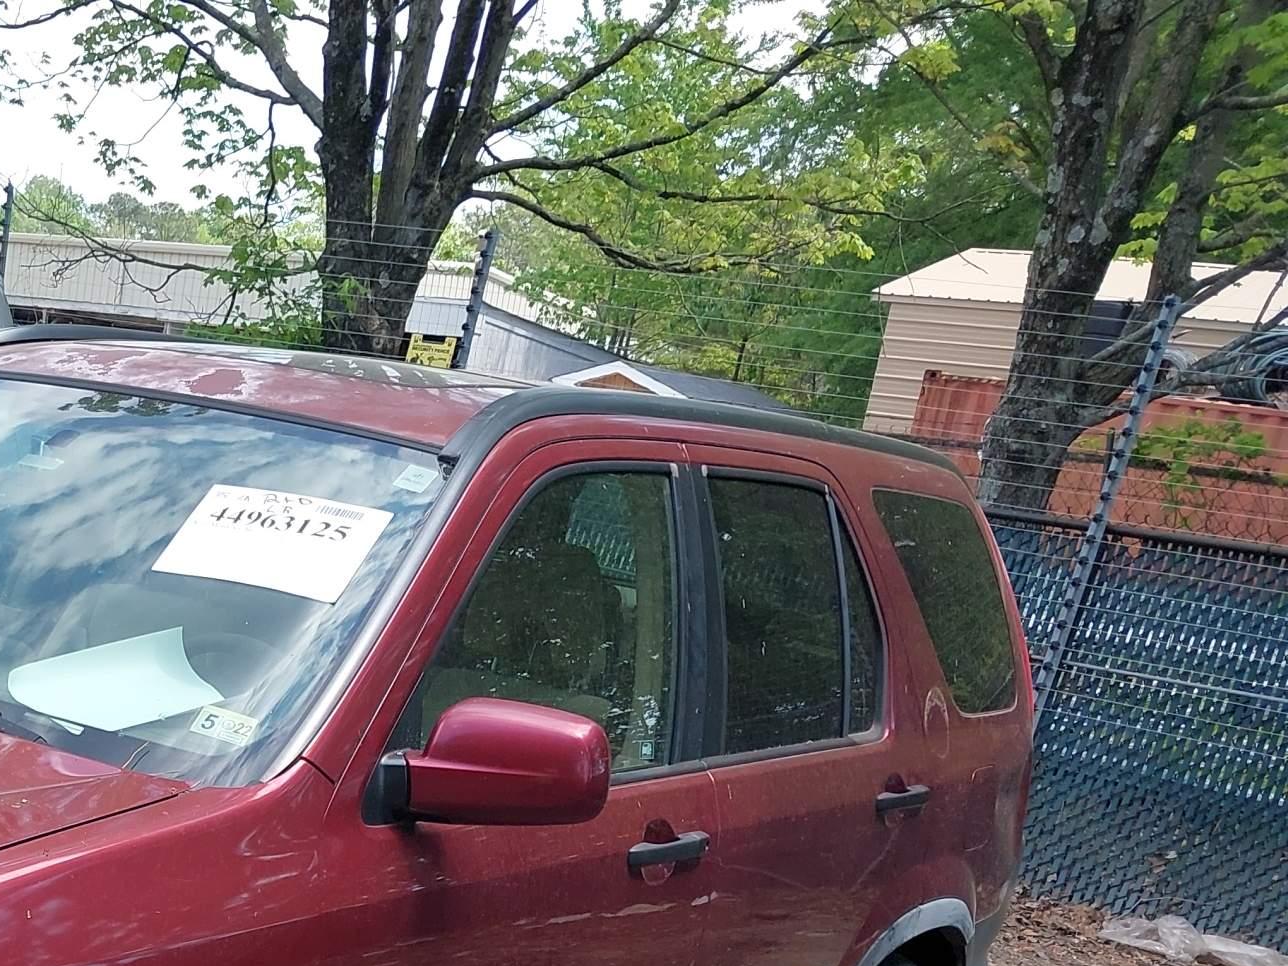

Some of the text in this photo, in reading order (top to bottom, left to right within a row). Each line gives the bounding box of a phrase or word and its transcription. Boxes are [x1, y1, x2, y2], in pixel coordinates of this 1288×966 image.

[210, 506, 352, 542] 44963125
[200, 713, 220, 730] 5
[232, 722, 254, 737] 22
